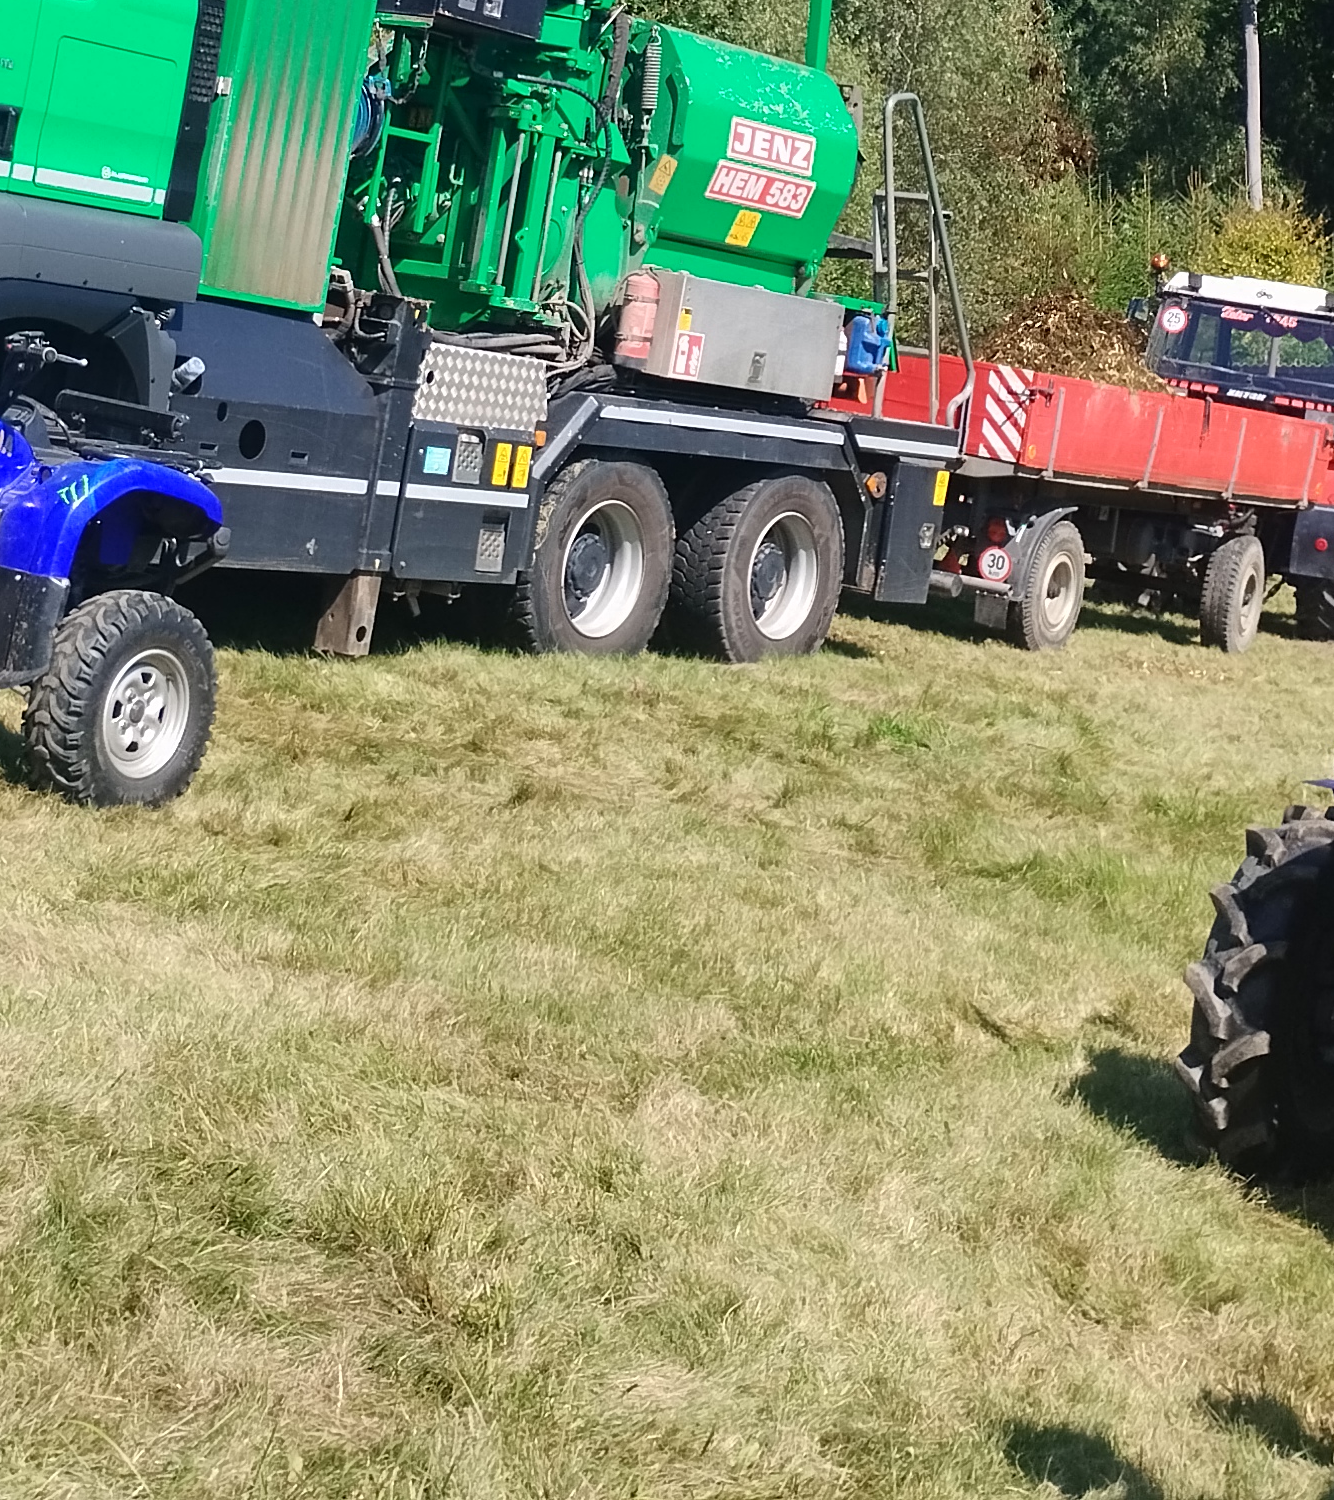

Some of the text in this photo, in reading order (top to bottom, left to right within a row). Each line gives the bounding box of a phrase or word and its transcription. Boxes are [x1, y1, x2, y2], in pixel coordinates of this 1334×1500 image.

[733, 124, 811, 169] JENZ
[712, 167, 808, 211] HEM 583
[1166, 311, 1181, 324] 25
[987, 553, 1006, 570] 30
